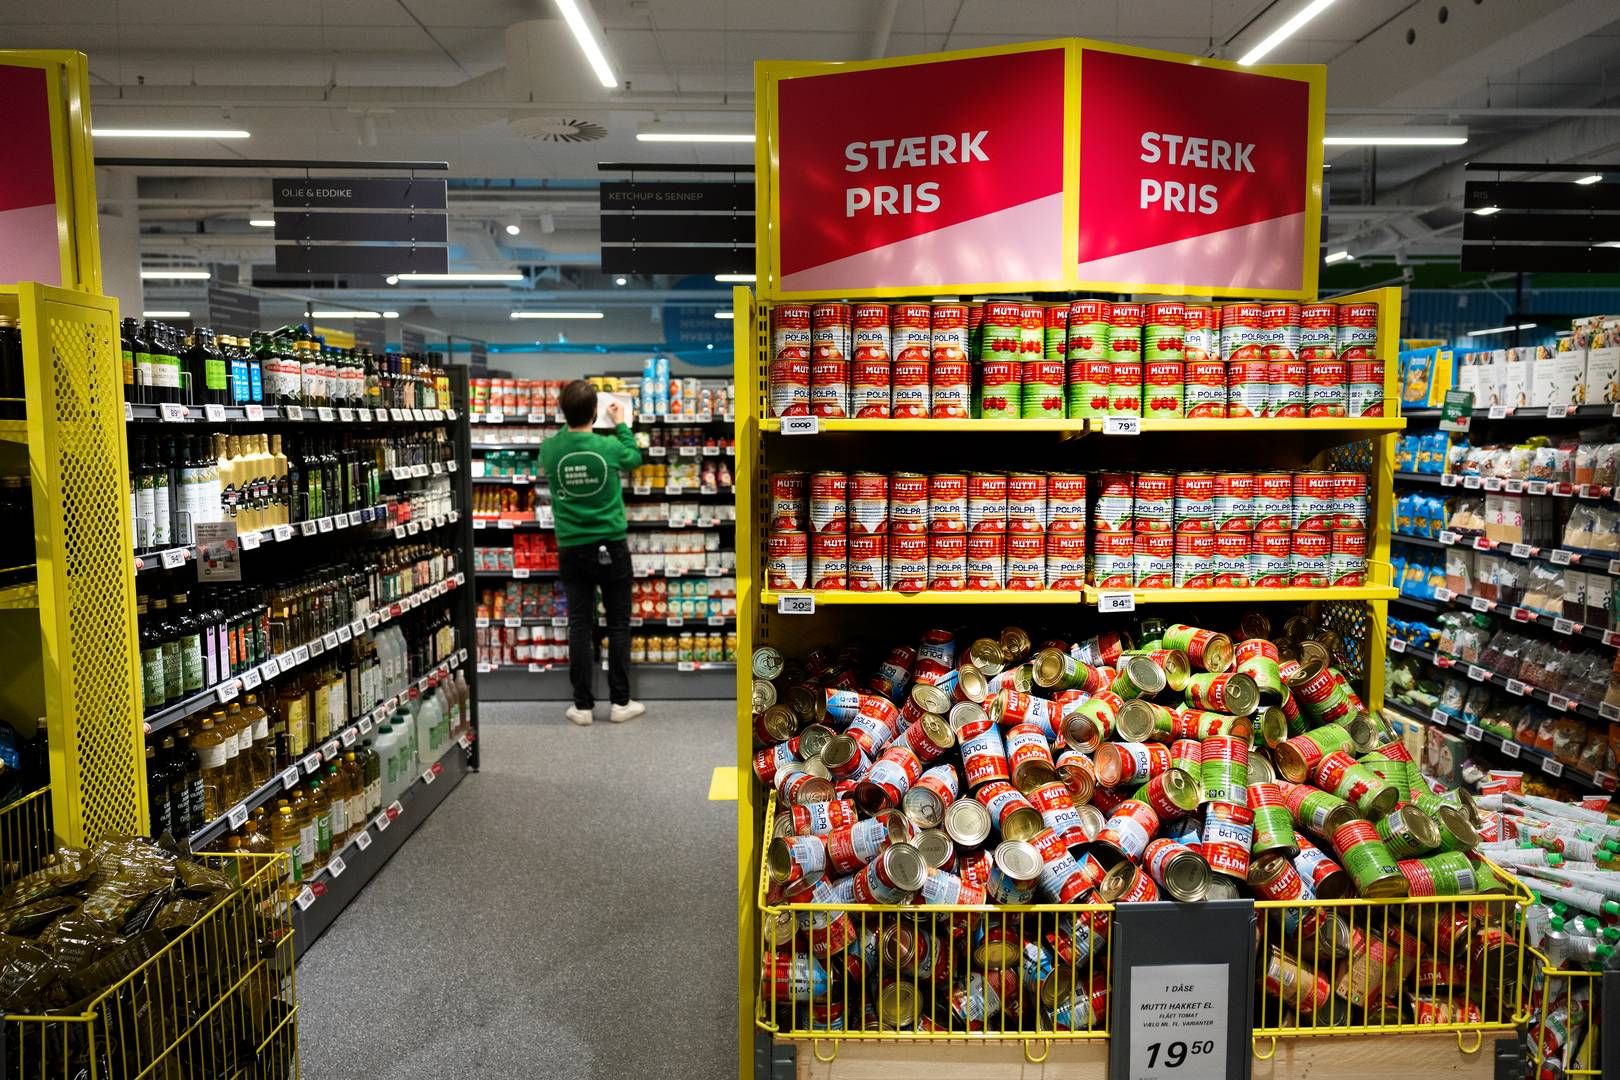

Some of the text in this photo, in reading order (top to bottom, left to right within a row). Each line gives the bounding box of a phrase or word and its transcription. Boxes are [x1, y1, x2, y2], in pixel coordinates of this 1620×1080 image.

[844, 130, 990, 173] STÆRK
[1140, 131, 1256, 173] STÆRK
[281, 188, 353, 198] OLIE & EDDIKE
[608, 192, 704, 201] KETCHUP & SENNEP
[1140, 178, 1218, 215] PRIS
[846, 181, 941, 218] PRIS
[857, 309, 883, 318] MUTTI
[934, 310, 960, 318] MUTTI
[1301, 309, 1330, 318] MUTTI
[858, 333, 882, 341] POLPA
[934, 334, 959, 342] POLPA
[1185, 335, 1201, 343] LPA
[1302, 333, 1330, 342] POLPA
[896, 367, 923, 375] MUTTI
[934, 367, 961, 375] MUTTI
[1151, 366, 1179, 375] MUTTI
[1313, 366, 1342, 375] MUTTI
[896, 391, 922, 399] POLPA
[935, 391, 960, 399] POLPA
[1313, 390, 1341, 399] POLPA
[895, 482, 922, 491] MUTTI
[934, 481, 961, 489] MUTTI
[1138, 480, 1166, 489] MUTTI
[895, 507, 921, 515] POLPA
[934, 505, 960, 513] POLPA
[1055, 506, 1081, 514] POLPA
[1138, 505, 1164, 513] POLPA
[936, 540, 963, 548] MUTTI
[1012, 540, 1039, 548] MUTTI
[1217, 537, 1246, 546] MUTTI
[1296, 537, 1326, 546] MUTTI
[901, 564, 926, 572] POLPA
[936, 564, 962, 572] POLPA
[1012, 563, 1039, 572] POLPA
[1218, 561, 1245, 570] POLPA
[1297, 561, 1324, 569] POLPA
[1112, 599, 1125, 608] 84
[1301, 674, 1329, 696] MUTTI
[854, 716, 876, 730] POLPA
[963, 743, 988, 758] POLPA
[1016, 750, 1047, 763] MUTTI
[1138, 750, 1148, 779] POLPA
[968, 765, 994, 780] MUTTI
[993, 790, 1021, 806] POLPA
[817, 803, 827, 830] POLPA
[1218, 829, 1249, 843] POLPA
[1213, 853, 1246, 872] MUTTI
[1270, 867, 1296, 895] MUTTI
[1127, 874, 1148, 902] MUTTI
[1171, 983, 1195, 993] DÅSE
[1140, 1003, 1167, 1011] MUTTI
[1168, 1002, 1202, 1010] HAKKET
[1146, 1040, 1214, 1069] 19 50
